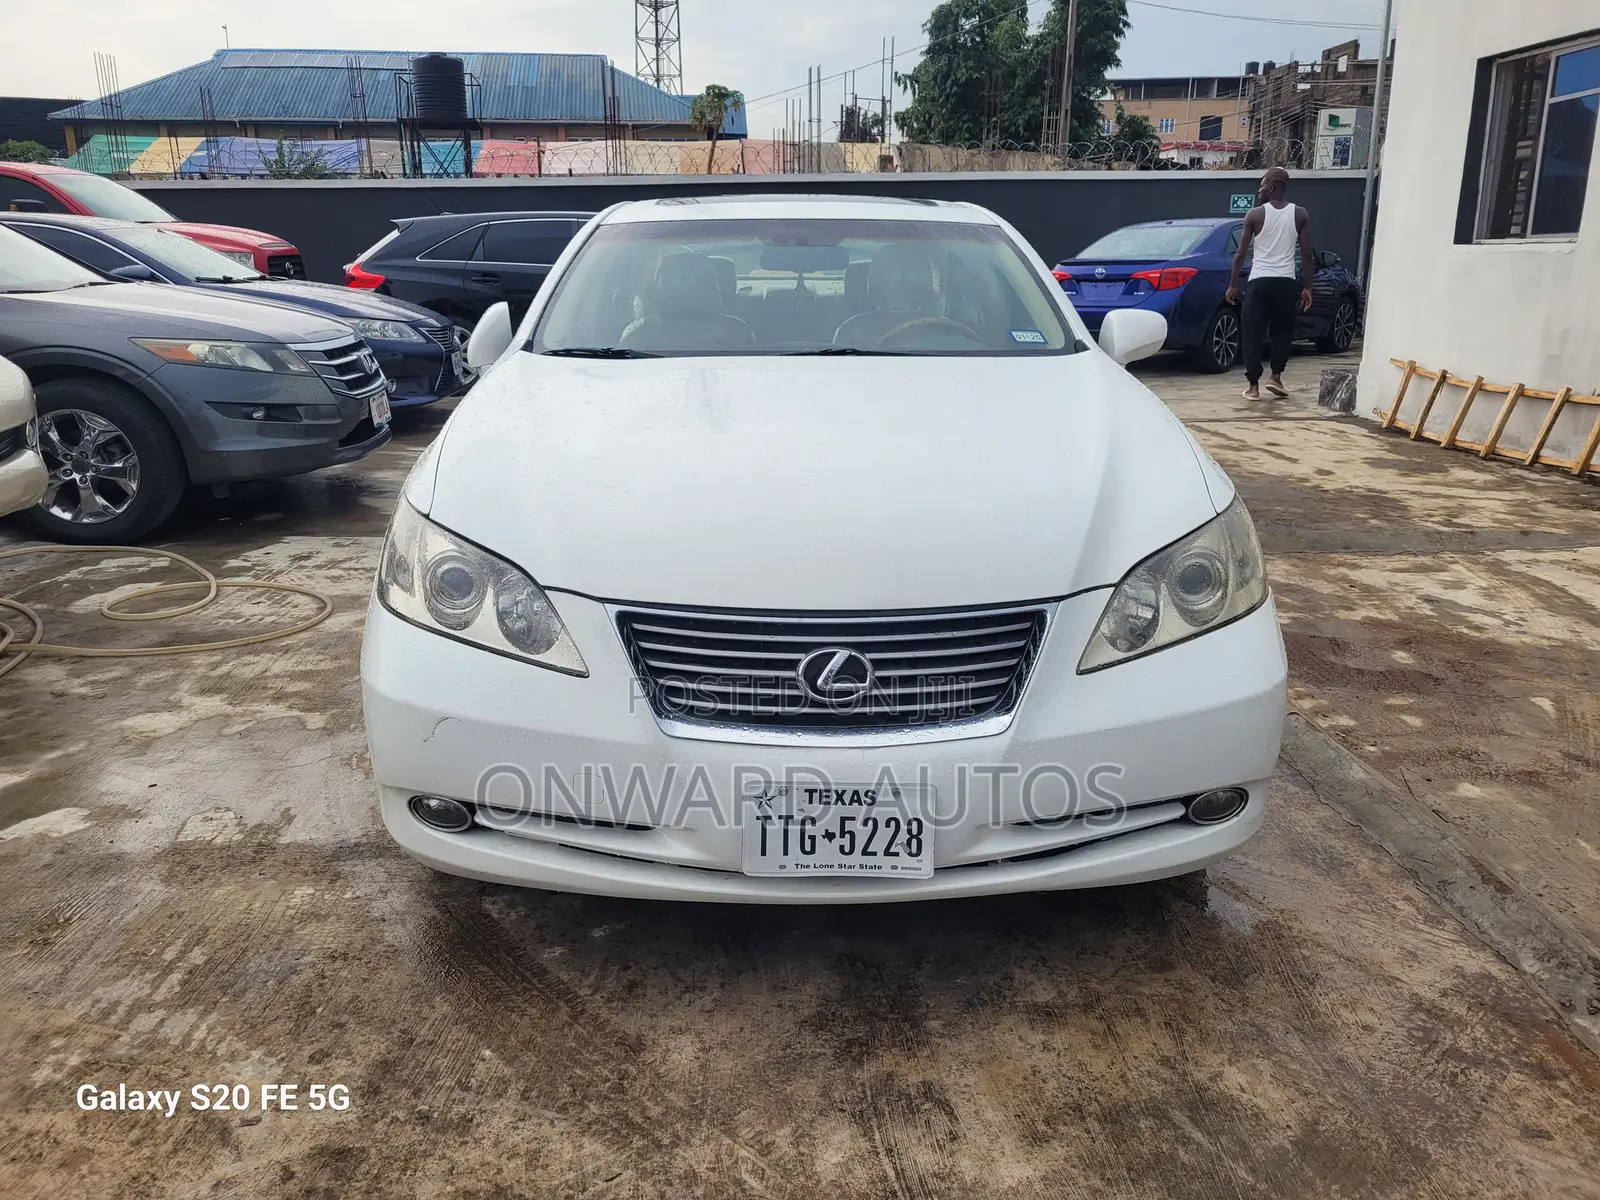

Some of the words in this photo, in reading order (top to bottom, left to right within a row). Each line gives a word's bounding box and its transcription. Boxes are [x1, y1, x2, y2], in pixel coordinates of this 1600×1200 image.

[804, 788, 877, 807] TEXAS
[813, 862, 835, 870] Lone
[858, 863, 883, 871] State
